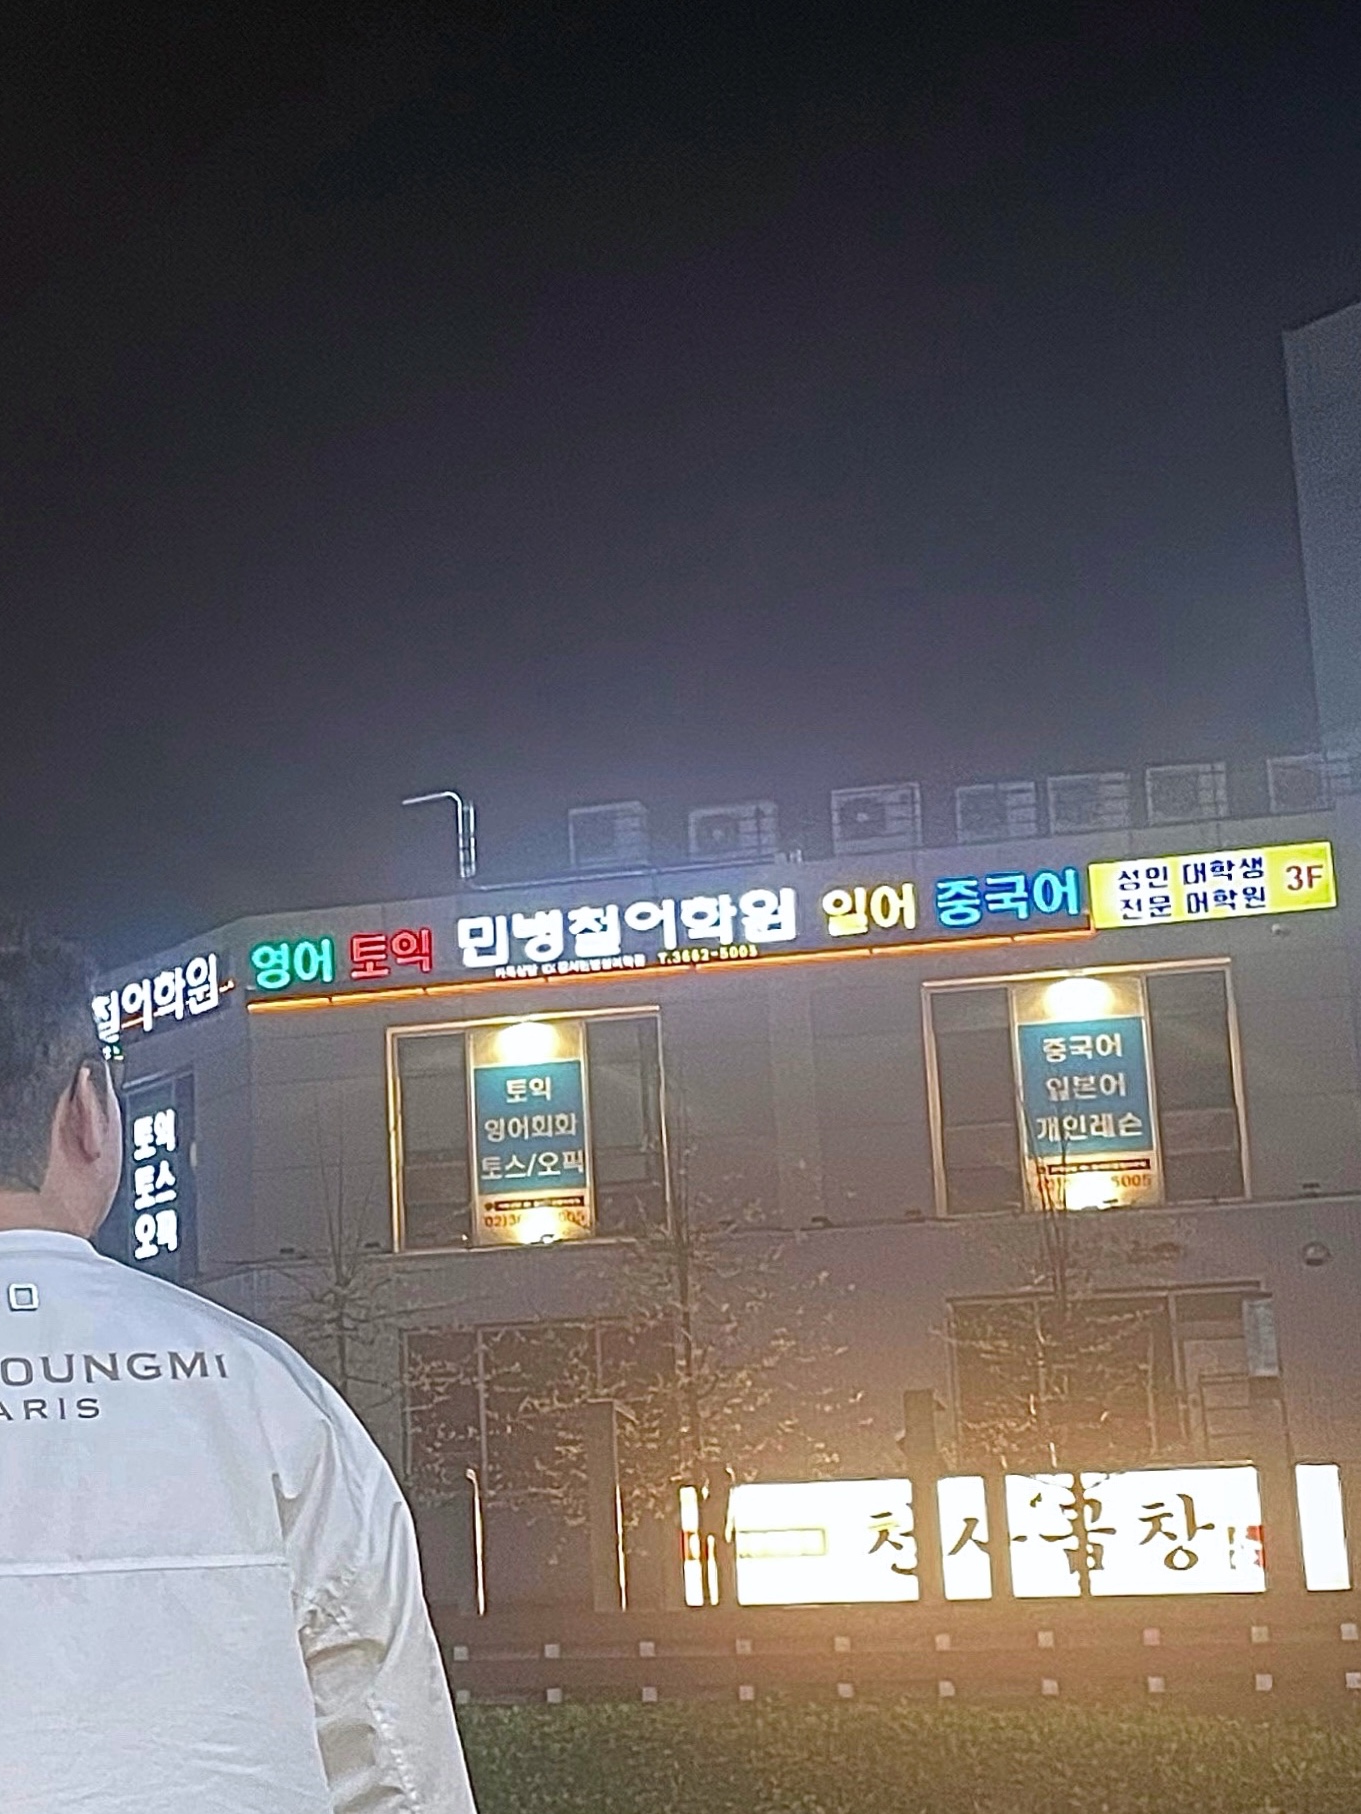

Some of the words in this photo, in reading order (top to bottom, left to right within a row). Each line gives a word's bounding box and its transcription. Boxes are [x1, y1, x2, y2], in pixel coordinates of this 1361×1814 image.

[1118, 865, 1169, 892] 성인
[1182, 856, 1265, 887] 대학생
[1284, 863, 1324, 892] 3F
[1119, 895, 1172, 921] 전문
[1186, 885, 1267, 914] 어학원
[251, 938, 334, 990] 영어
[349, 928, 432, 980] 토익
[457, 887, 797, 968] 민병철어학원
[822, 882, 917, 937] 일어
[936, 867, 1080, 930] 중국어
[1042, 1032, 1123, 1063] 중국어
[506, 1076, 552, 1104] 토익
[1036, 1111, 1144, 1142] 개인레슨
[480, 1150, 585, 1181] 토스/오픽
